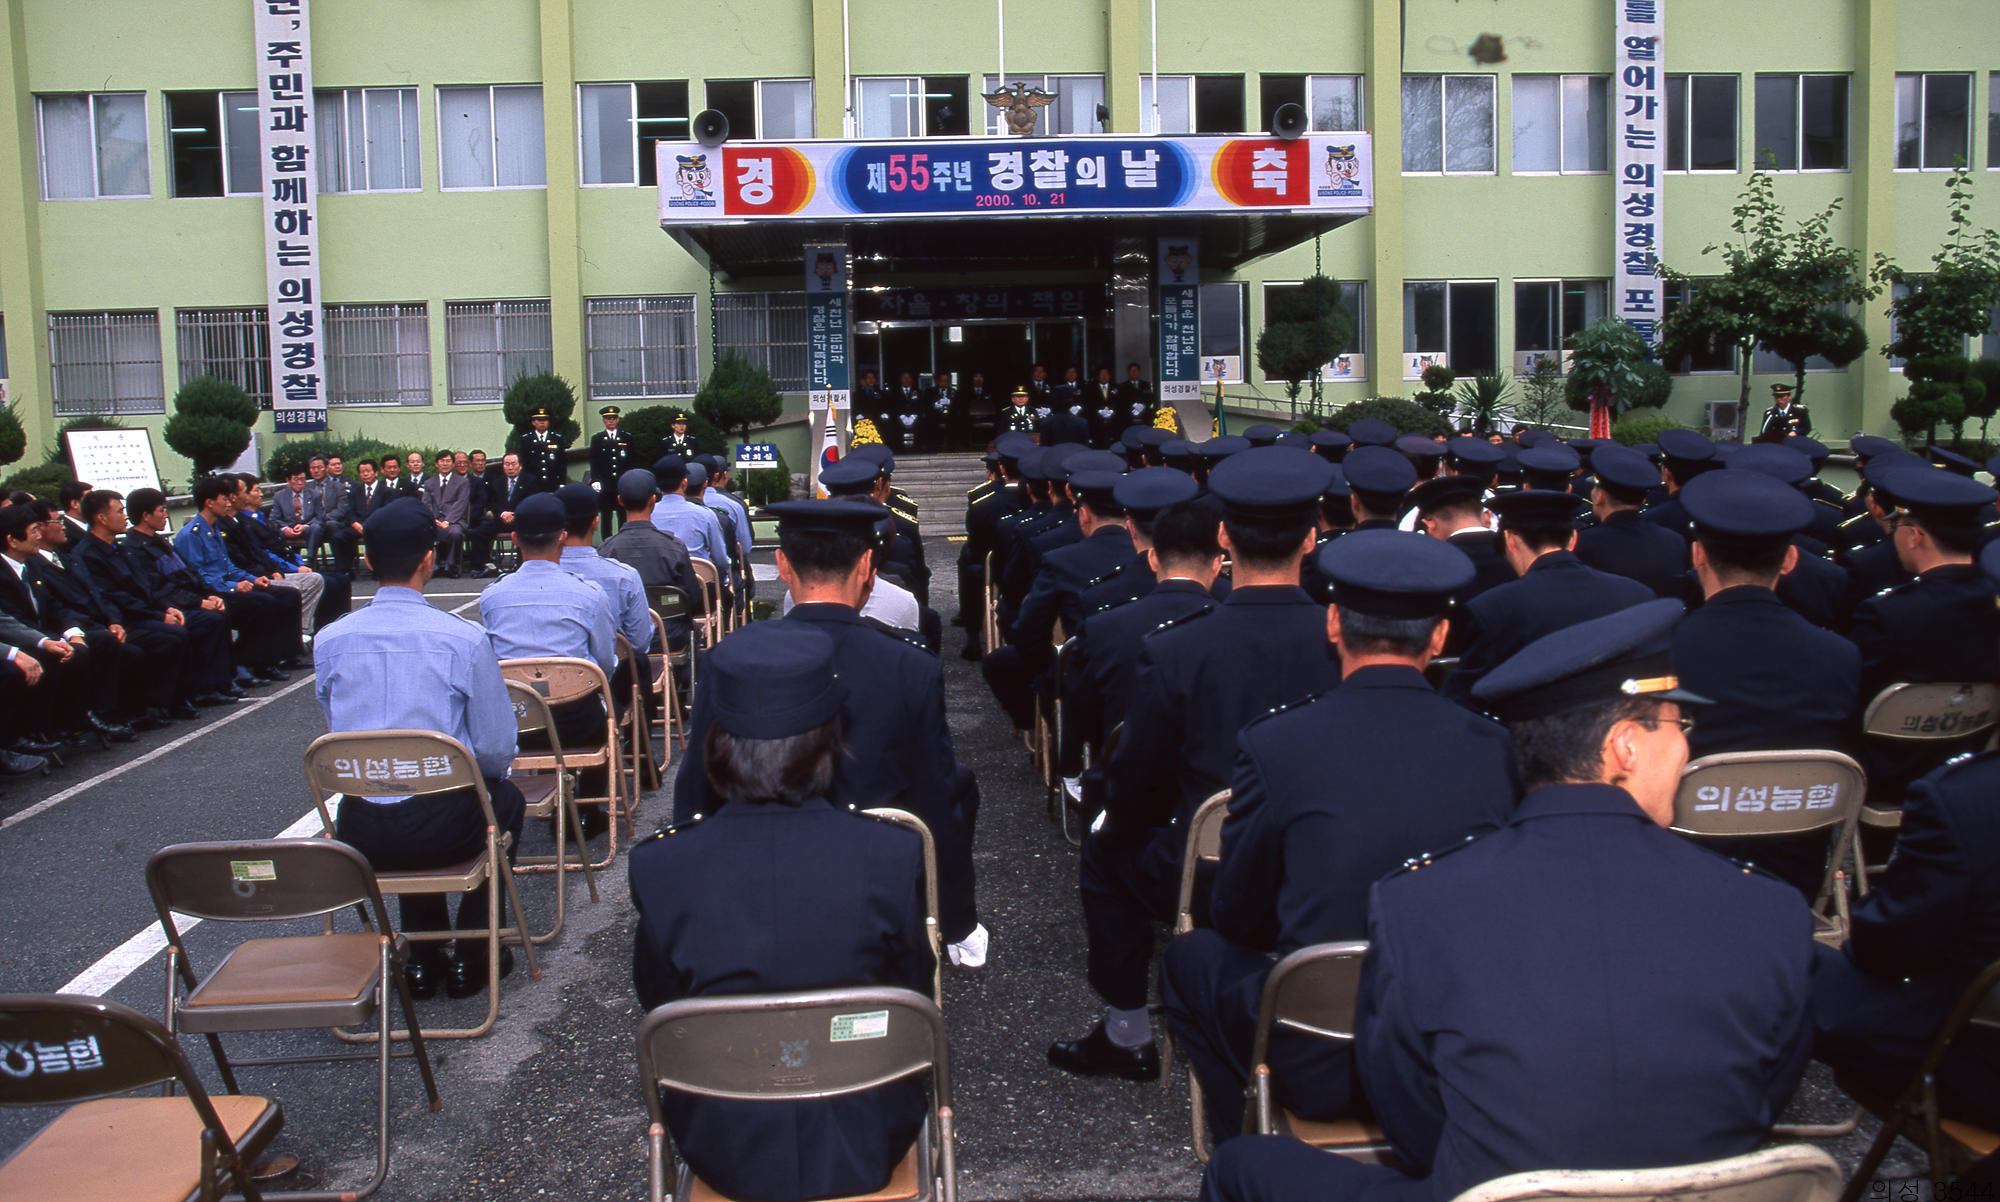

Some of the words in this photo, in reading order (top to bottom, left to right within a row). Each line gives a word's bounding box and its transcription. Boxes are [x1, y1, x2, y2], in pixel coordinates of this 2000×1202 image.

[267, 41, 308, 133] 주민과
[1622, 36, 1659, 149] 열어가는
[736, 157, 774, 205] 경
[866, 153, 972, 194] 제55주년
[987, 149, 1107, 191] 경찰의
[1121, 149, 1160, 188] 날
[1251, 147, 1288, 196] 축
[271, 145, 313, 266] 함께하는
[1050, 192, 1066, 205] 21
[1622, 163, 1657, 276] 의성경찰
[277, 278, 321, 401] 의성경찰
[1623, 288, 1656, 362] 포돌
[1164, 384, 1198, 394] 의성경찰서
[275, 410, 327, 424] 의성경찰서
[334, 753, 454, 781] 의성농협
[1694, 781, 1839, 813] 의성농협
